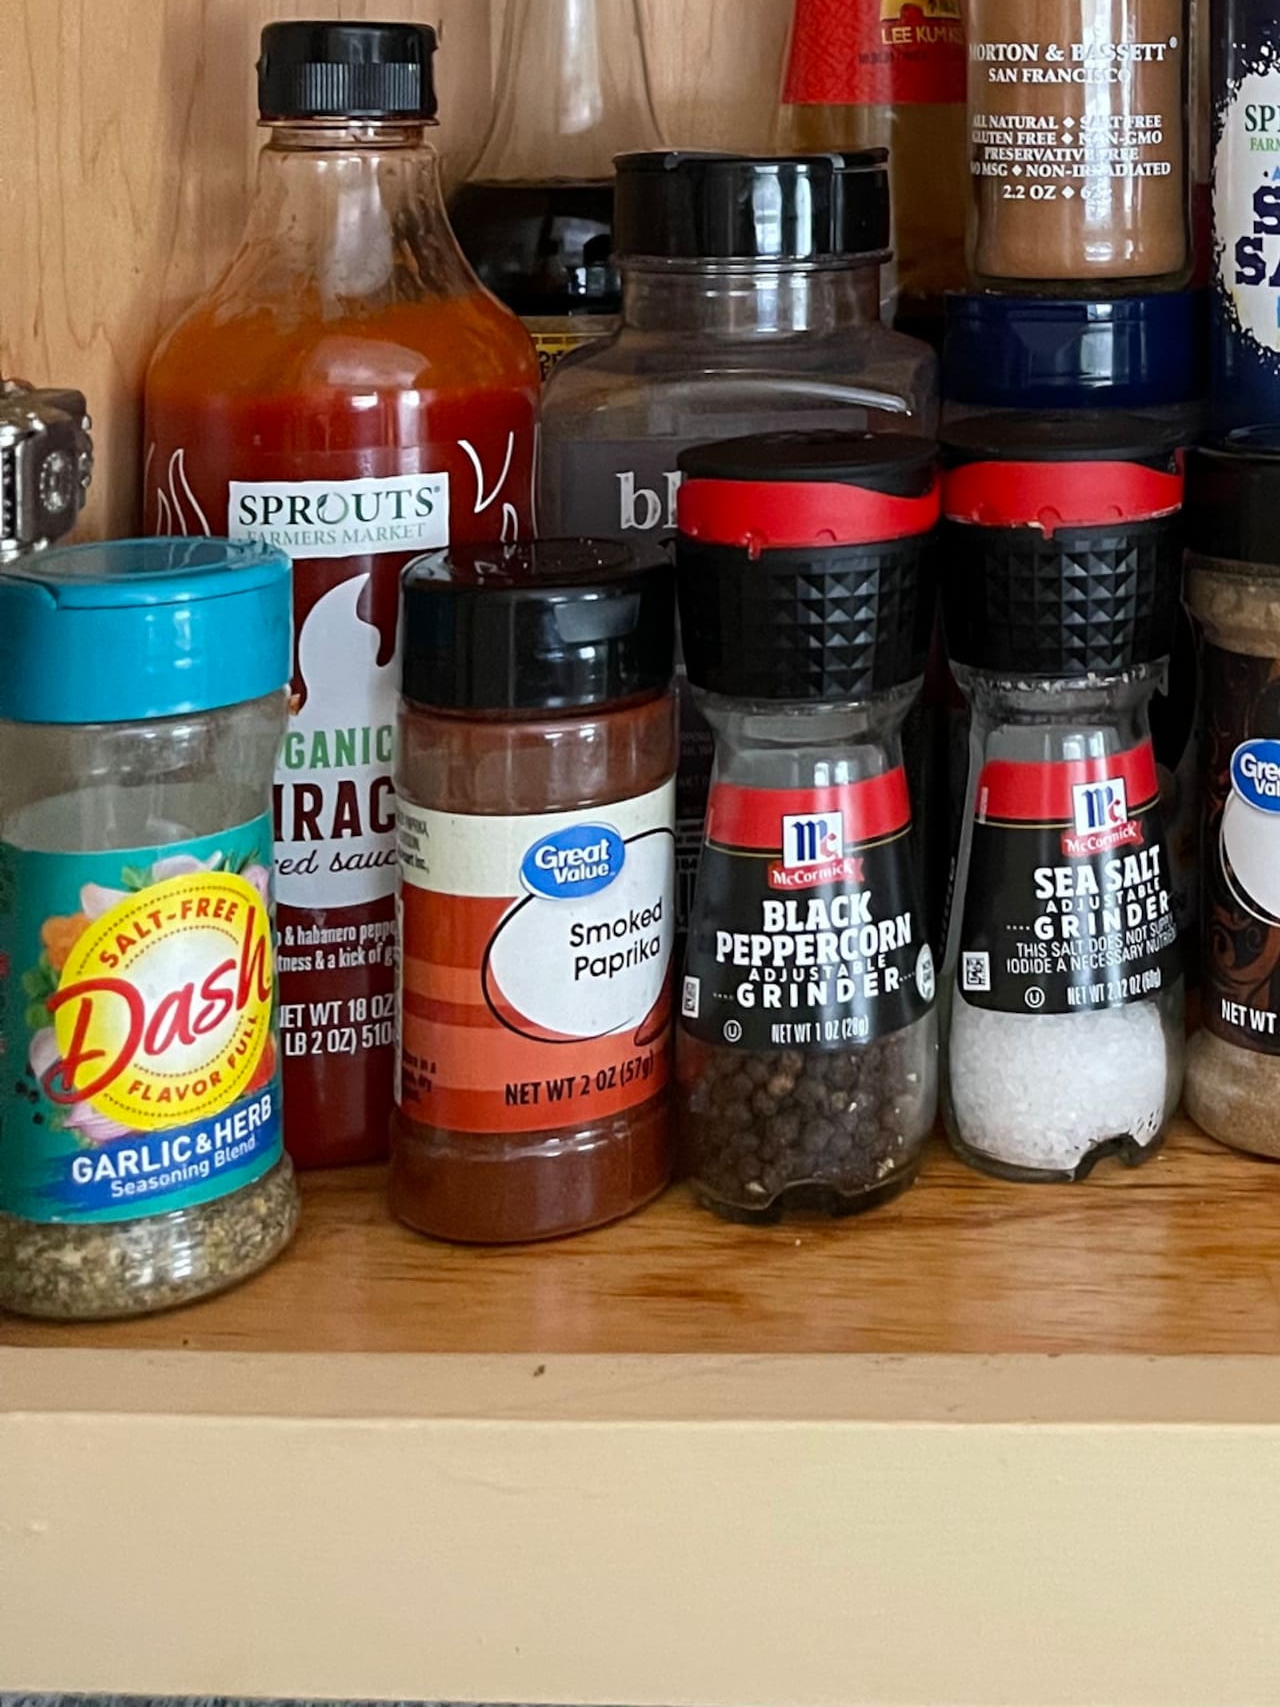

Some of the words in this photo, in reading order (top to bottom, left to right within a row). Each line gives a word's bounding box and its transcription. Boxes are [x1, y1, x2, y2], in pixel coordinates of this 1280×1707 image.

[881, 26, 913, 45] LEE
[1045, 44, 1065, 61] &
[988, 68, 1018, 83] SAN
[1022, 68, 1132, 83] FRANCISCO
[972, 131, 1013, 144] GLUTEN
[1018, 131, 1056, 145] FREE
[989, 115, 1059, 129] NATURAL
[1128, 115, 1162, 129] FREE
[982, 163, 1008, 177] MSG
[1003, 185, 1025, 199] 2.2
[1030, 185, 1057, 199] OZ
[239, 486, 433, 526] SPROUTS
[247, 529, 336, 547] FARMERS
[342, 523, 426, 544] MARKET
[283, 724, 393, 770] GANIC
[273, 776, 397, 843] IRAC
[535, 838, 610, 870] Great
[1064, 822, 1138, 854] McCormick
[553, 862, 609, 886] Value
[772, 863, 854, 886] McCormick
[1034, 865, 1099, 900] SEA
[1104, 845, 1161, 893] SALT
[763, 891, 872, 932] BLACK
[1046, 877, 1161, 914] ADJUSTABLE
[569, 896, 663, 947] Smoked
[1034, 890, 1169, 940] GRINDER
[99, 897, 240, 968] SALT-FREE
[285, 925, 294, 946] &
[297, 924, 356, 945] habanero
[716, 913, 912, 967] PEPPERCORN
[1016, 942, 1047, 959] THIS
[1051, 939, 1083, 959] SALT
[1089, 934, 1123, 953] DOES
[1126, 925, 1148, 945] NOT
[315, 950, 325, 970] &
[327, 954, 335, 968] a
[339, 945, 366, 968] kick
[369, 942, 383, 963] of
[574, 935, 661, 981] Paprika
[749, 954, 886, 982] ADJUSTABLE
[1007, 958, 1052, 974] IODIDE
[1056, 957, 1067, 973] A
[1070, 943, 1144, 972] NECESSARY
[737, 967, 900, 1008] GRINDER
[1067, 986, 1087, 1006] NET
[1089, 983, 1105, 1003] WT
[1129, 974, 1141, 995] OZ
[44, 905, 273, 1104] Dash
[309, 1001, 343, 1027] WT
[348, 998, 367, 1023] 18
[371, 993, 394, 1019] OZ
[1221, 998, 1248, 1027] NET
[1249, 1007, 1277, 1035] WT
[227, 1014, 259, 1070] FULL
[285, 1032, 307, 1056] LB
[311, 1030, 322, 1054] 2
[327, 1027, 357, 1054] OZ)
[771, 1023, 791, 1044] NET
[794, 1023, 812, 1043] WT
[815, 1022, 821, 1042] 1
[824, 1021, 840, 1041] OZ
[128, 1071, 223, 1104] FLAVOR
[505, 1081, 542, 1106] NET
[546, 1076, 576, 1103] WT
[580, 1074, 590, 1096] 2
[596, 1066, 617, 1092] OZ
[620, 1047, 655, 1084] (57g)
[72, 1132, 192, 1185] GARLIC
[195, 1132, 213, 1155] &
[214, 1094, 272, 1151] HERB
[111, 1155, 211, 1198] Seasoning
[214, 1136, 257, 1169] Blend
